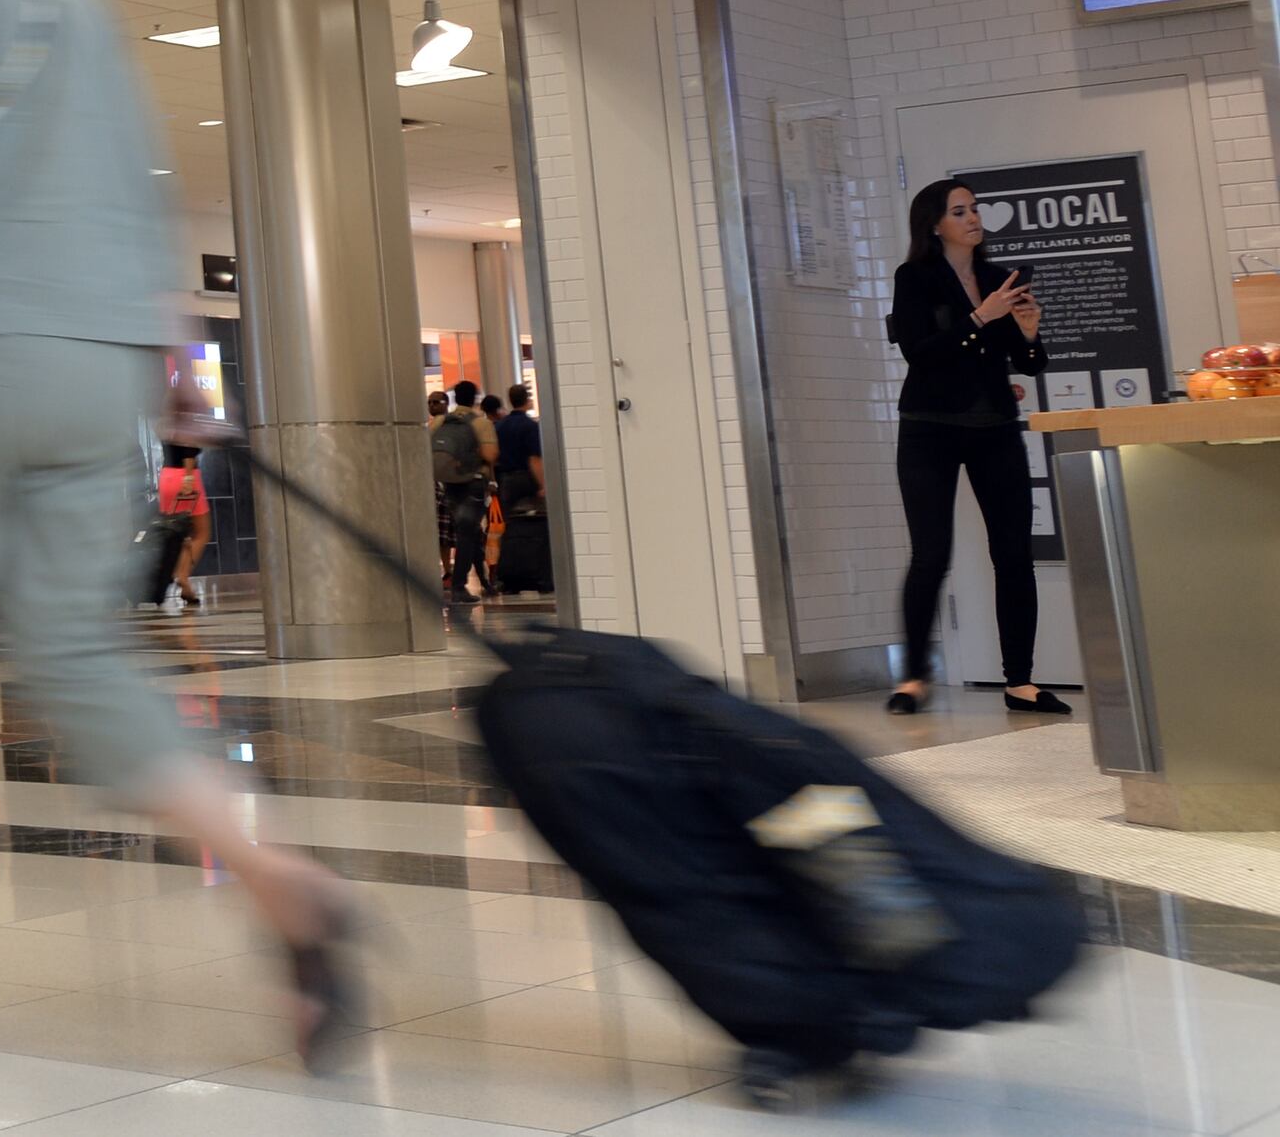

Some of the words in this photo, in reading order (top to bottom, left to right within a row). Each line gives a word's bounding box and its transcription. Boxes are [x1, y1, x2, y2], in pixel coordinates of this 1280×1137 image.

[1017, 192, 1128, 231] LOCAL
[987, 244, 1005, 253] EST
[1008, 242, 1024, 251] OF
[1027, 238, 1081, 249] ATLANTA
[1084, 233, 1132, 244] FLAVOR
[1062, 261, 1081, 269] right
[1091, 267, 1117, 275] coffee
[1080, 317, 1124, 325] experience
[1047, 352, 1069, 360] Local
